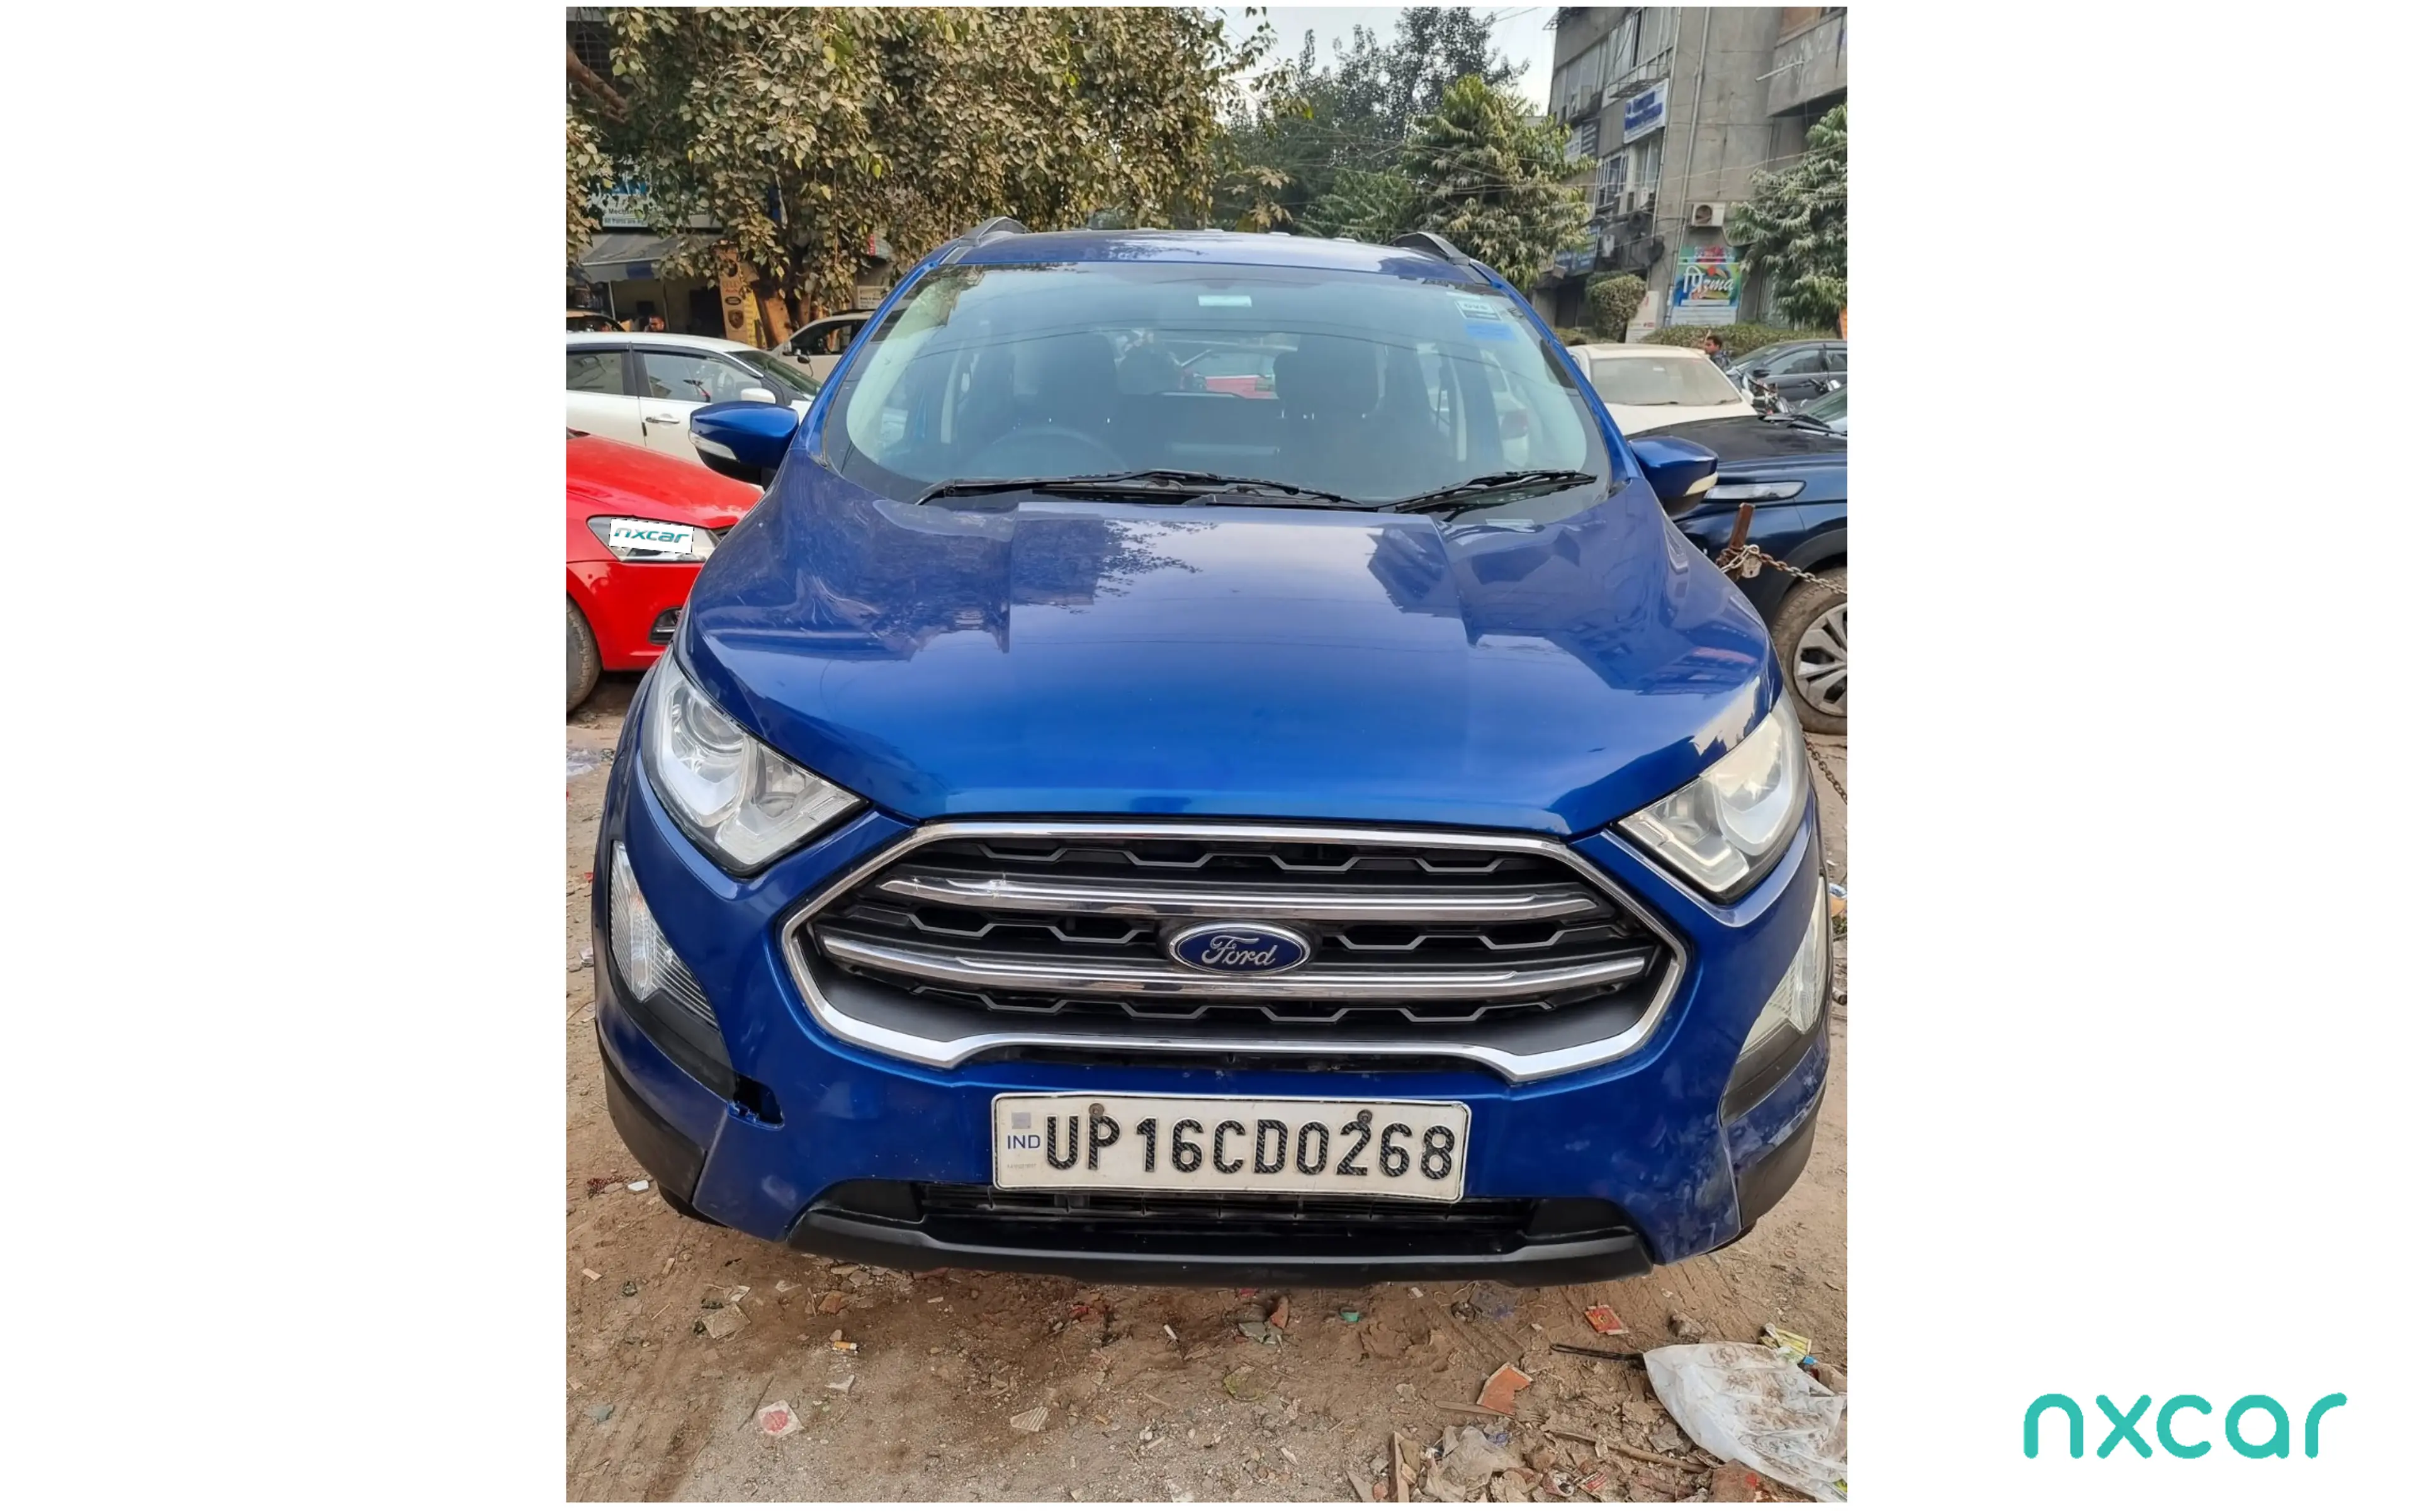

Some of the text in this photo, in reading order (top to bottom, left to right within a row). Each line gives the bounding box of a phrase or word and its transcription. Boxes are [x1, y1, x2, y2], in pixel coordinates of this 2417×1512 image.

[1202, 935, 1278, 966] Ford
[1008, 1135, 1040, 1149] IND
[1047, 1115, 1455, 1180] UP16CD0268
